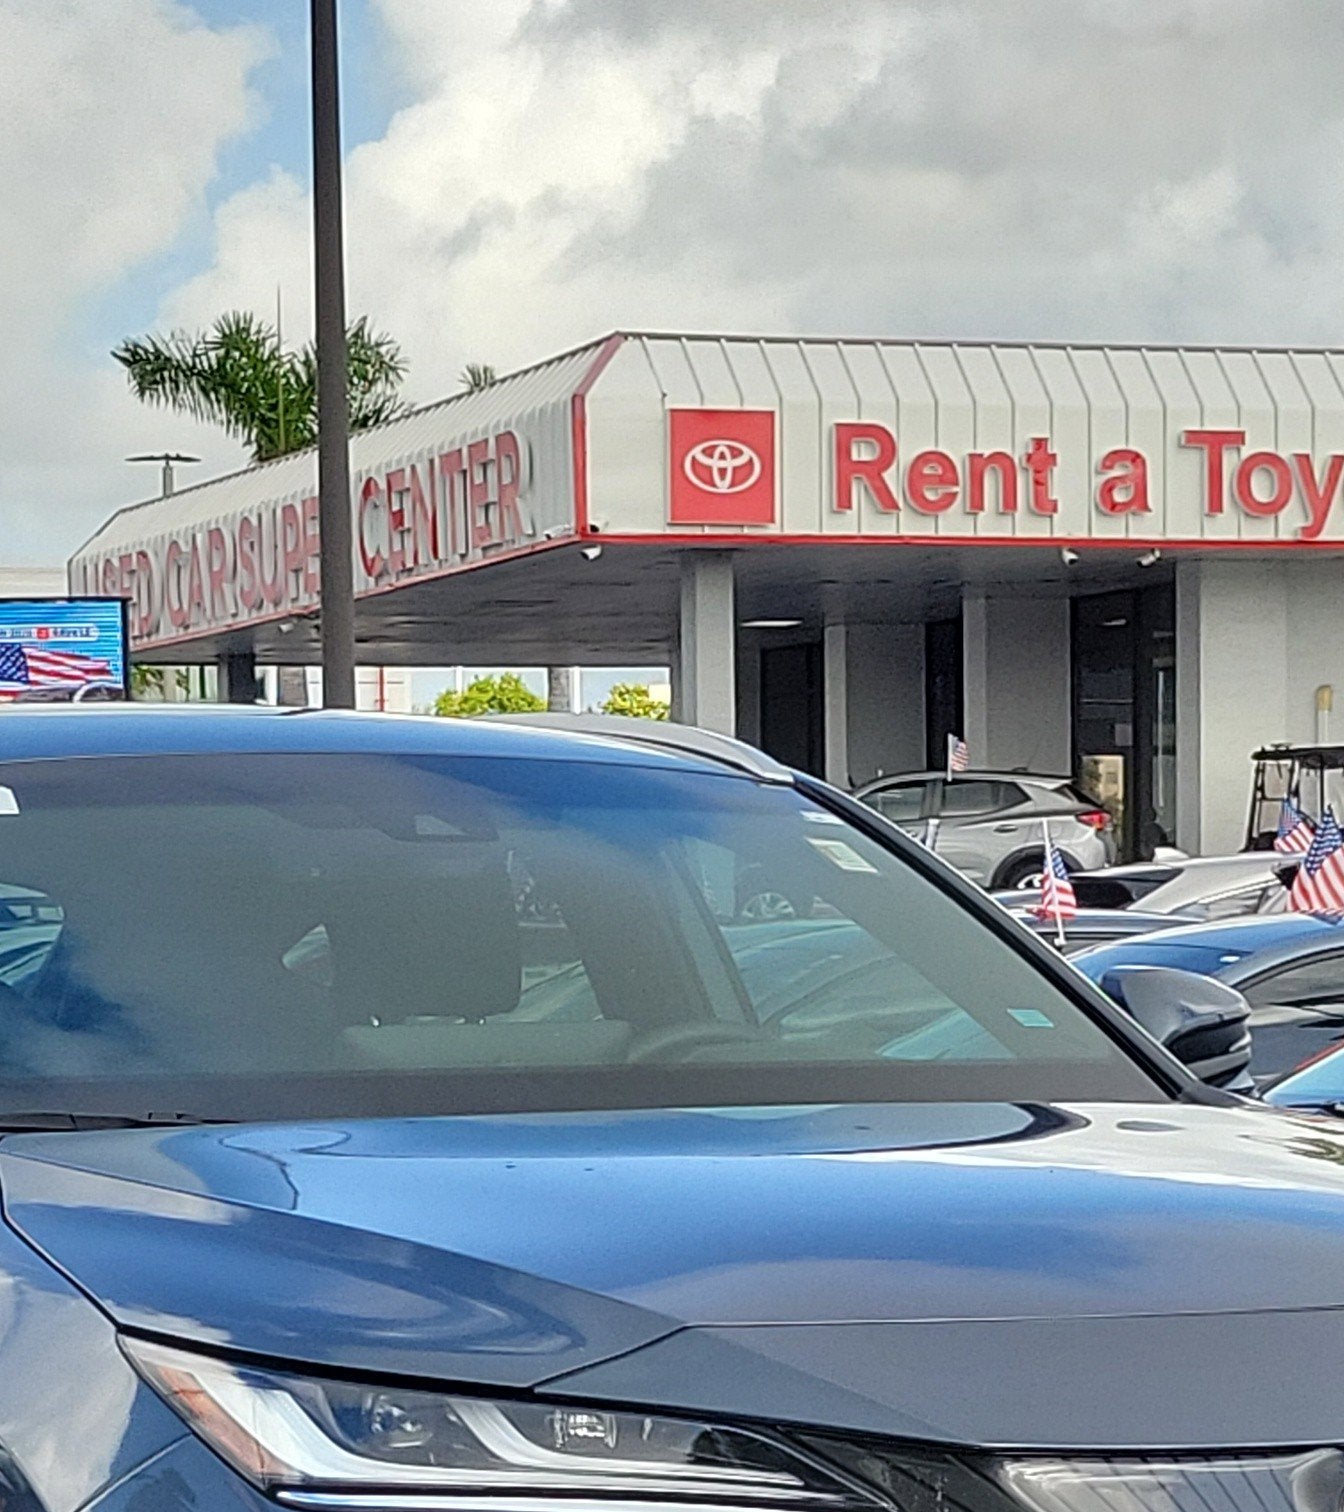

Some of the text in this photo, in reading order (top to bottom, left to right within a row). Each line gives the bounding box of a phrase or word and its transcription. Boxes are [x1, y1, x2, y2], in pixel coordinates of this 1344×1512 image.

[164, 526, 236, 629] CAR
[238, 497, 320, 611] SUPE
[359, 430, 533, 578] CENTER
[832, 422, 1058, 517] Rent
[1096, 446, 1152, 516] a
